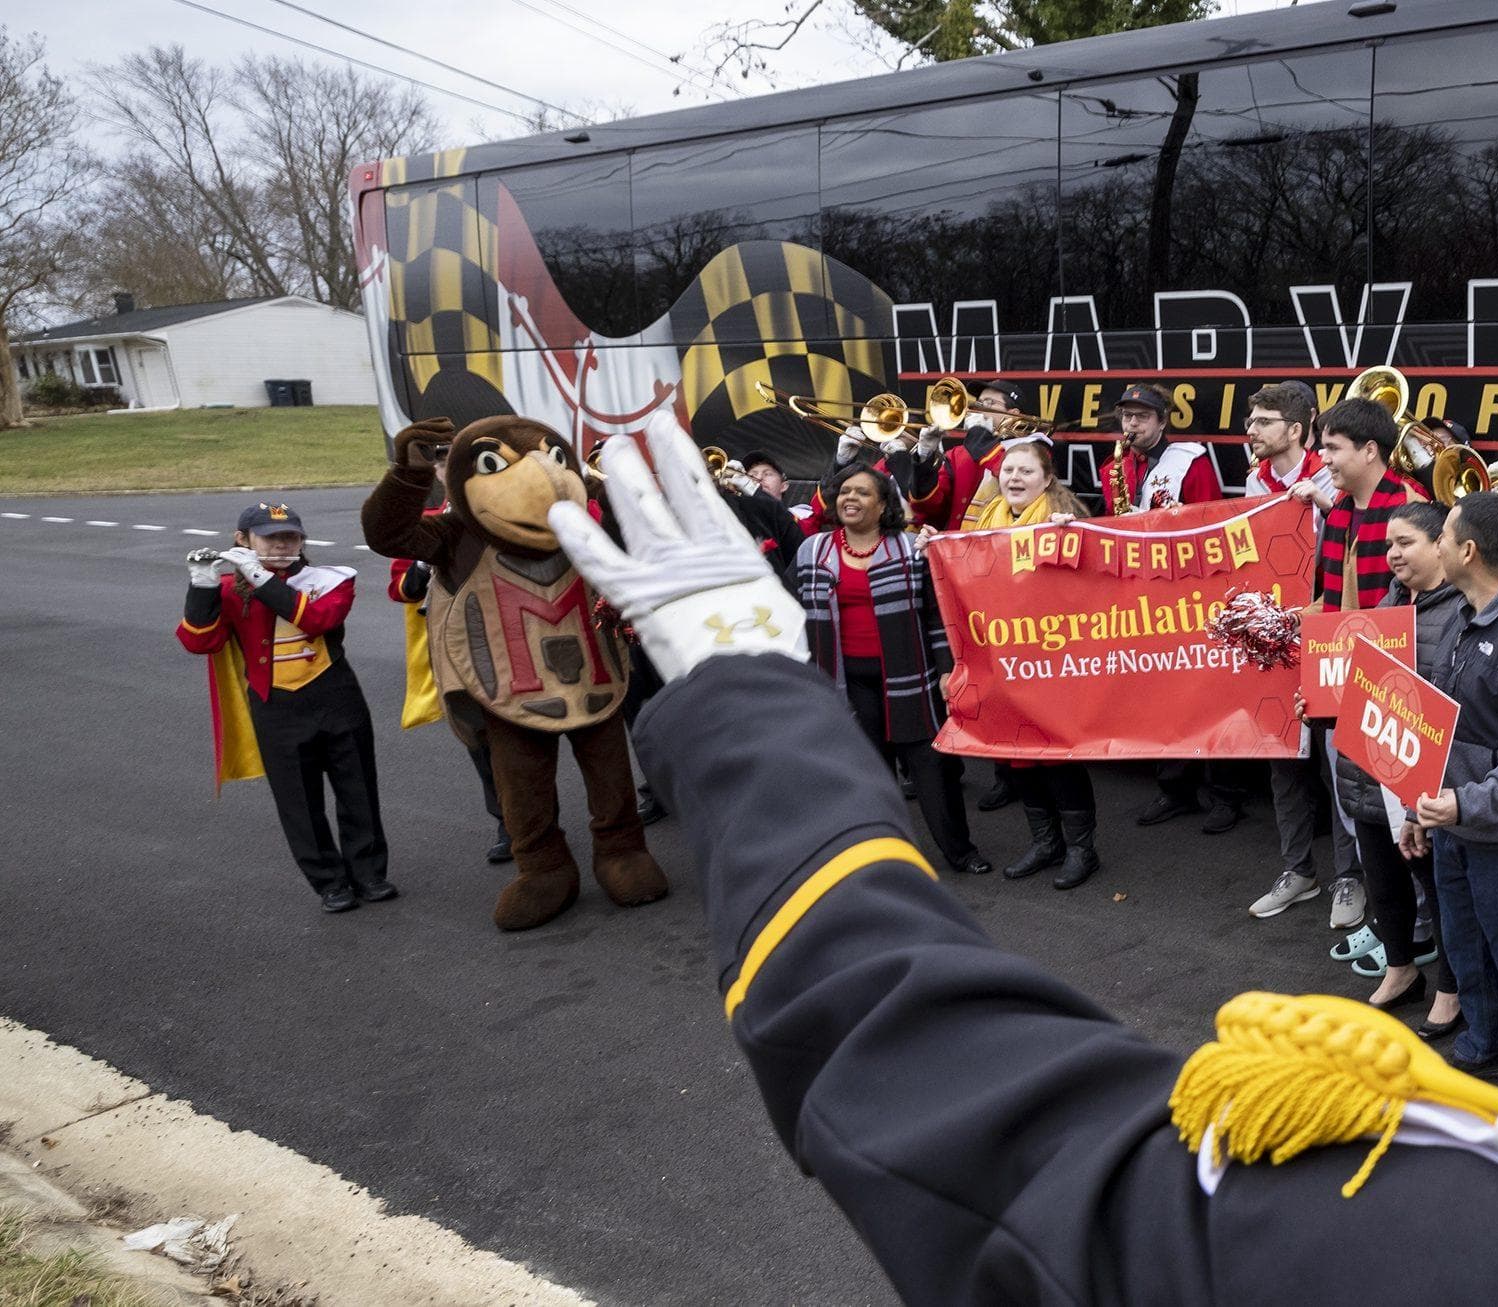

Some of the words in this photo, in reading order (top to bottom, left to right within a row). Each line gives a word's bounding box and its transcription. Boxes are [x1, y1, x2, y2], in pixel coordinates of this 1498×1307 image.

[1037, 531, 1079, 558] GO
[1100, 536, 1224, 570] TERPS
[999, 656, 1054, 681] You
[1059, 653, 1101, 678] Are
[1105, 643, 1248, 674] #NowATerp
[1307, 637, 1344, 655] Proud
[1353, 667, 1388, 704] Proud
[1389, 691, 1446, 746] Maryland
[1360, 699, 1421, 768] DAD
